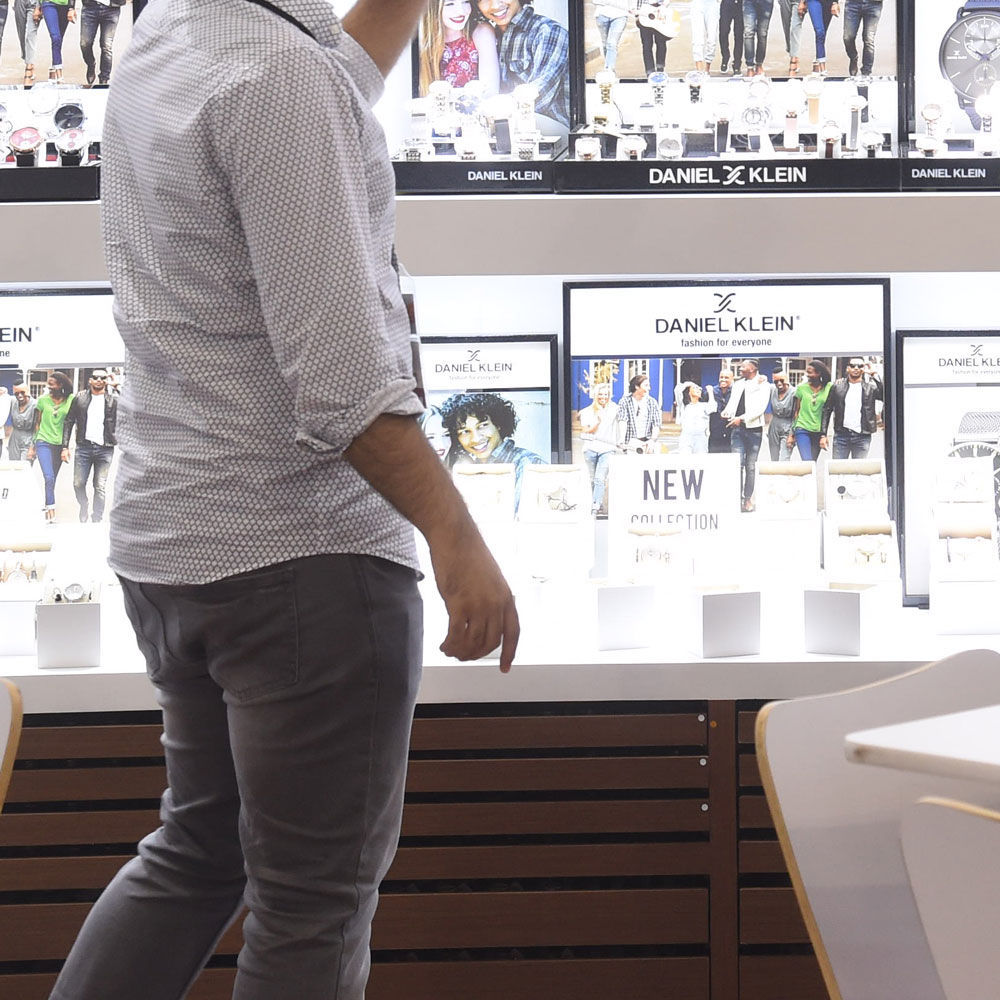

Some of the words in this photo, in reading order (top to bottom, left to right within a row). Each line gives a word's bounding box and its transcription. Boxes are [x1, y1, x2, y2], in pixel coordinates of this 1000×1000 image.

[468, 170, 508, 181] DANIEL
[510, 170, 543, 181] KLEIN
[650, 167, 720, 183] DANIEL
[748, 166, 807, 183] KLEIN
[911, 168, 952, 179] DANIEL
[953, 168, 986, 179] KLEIN
[655, 317, 730, 334] DANIEL
[734, 315, 794, 332] KLEIN
[0, 327, 32, 343] EIN
[680, 337, 714, 348] fashion
[716, 337, 729, 347] for
[731, 338, 773, 349] everyone
[435, 363, 477, 373] DANIEL
[479, 362, 513, 372] KLEIN
[938, 357, 979, 367] DANIEL
[644, 469, 705, 501] NEW
